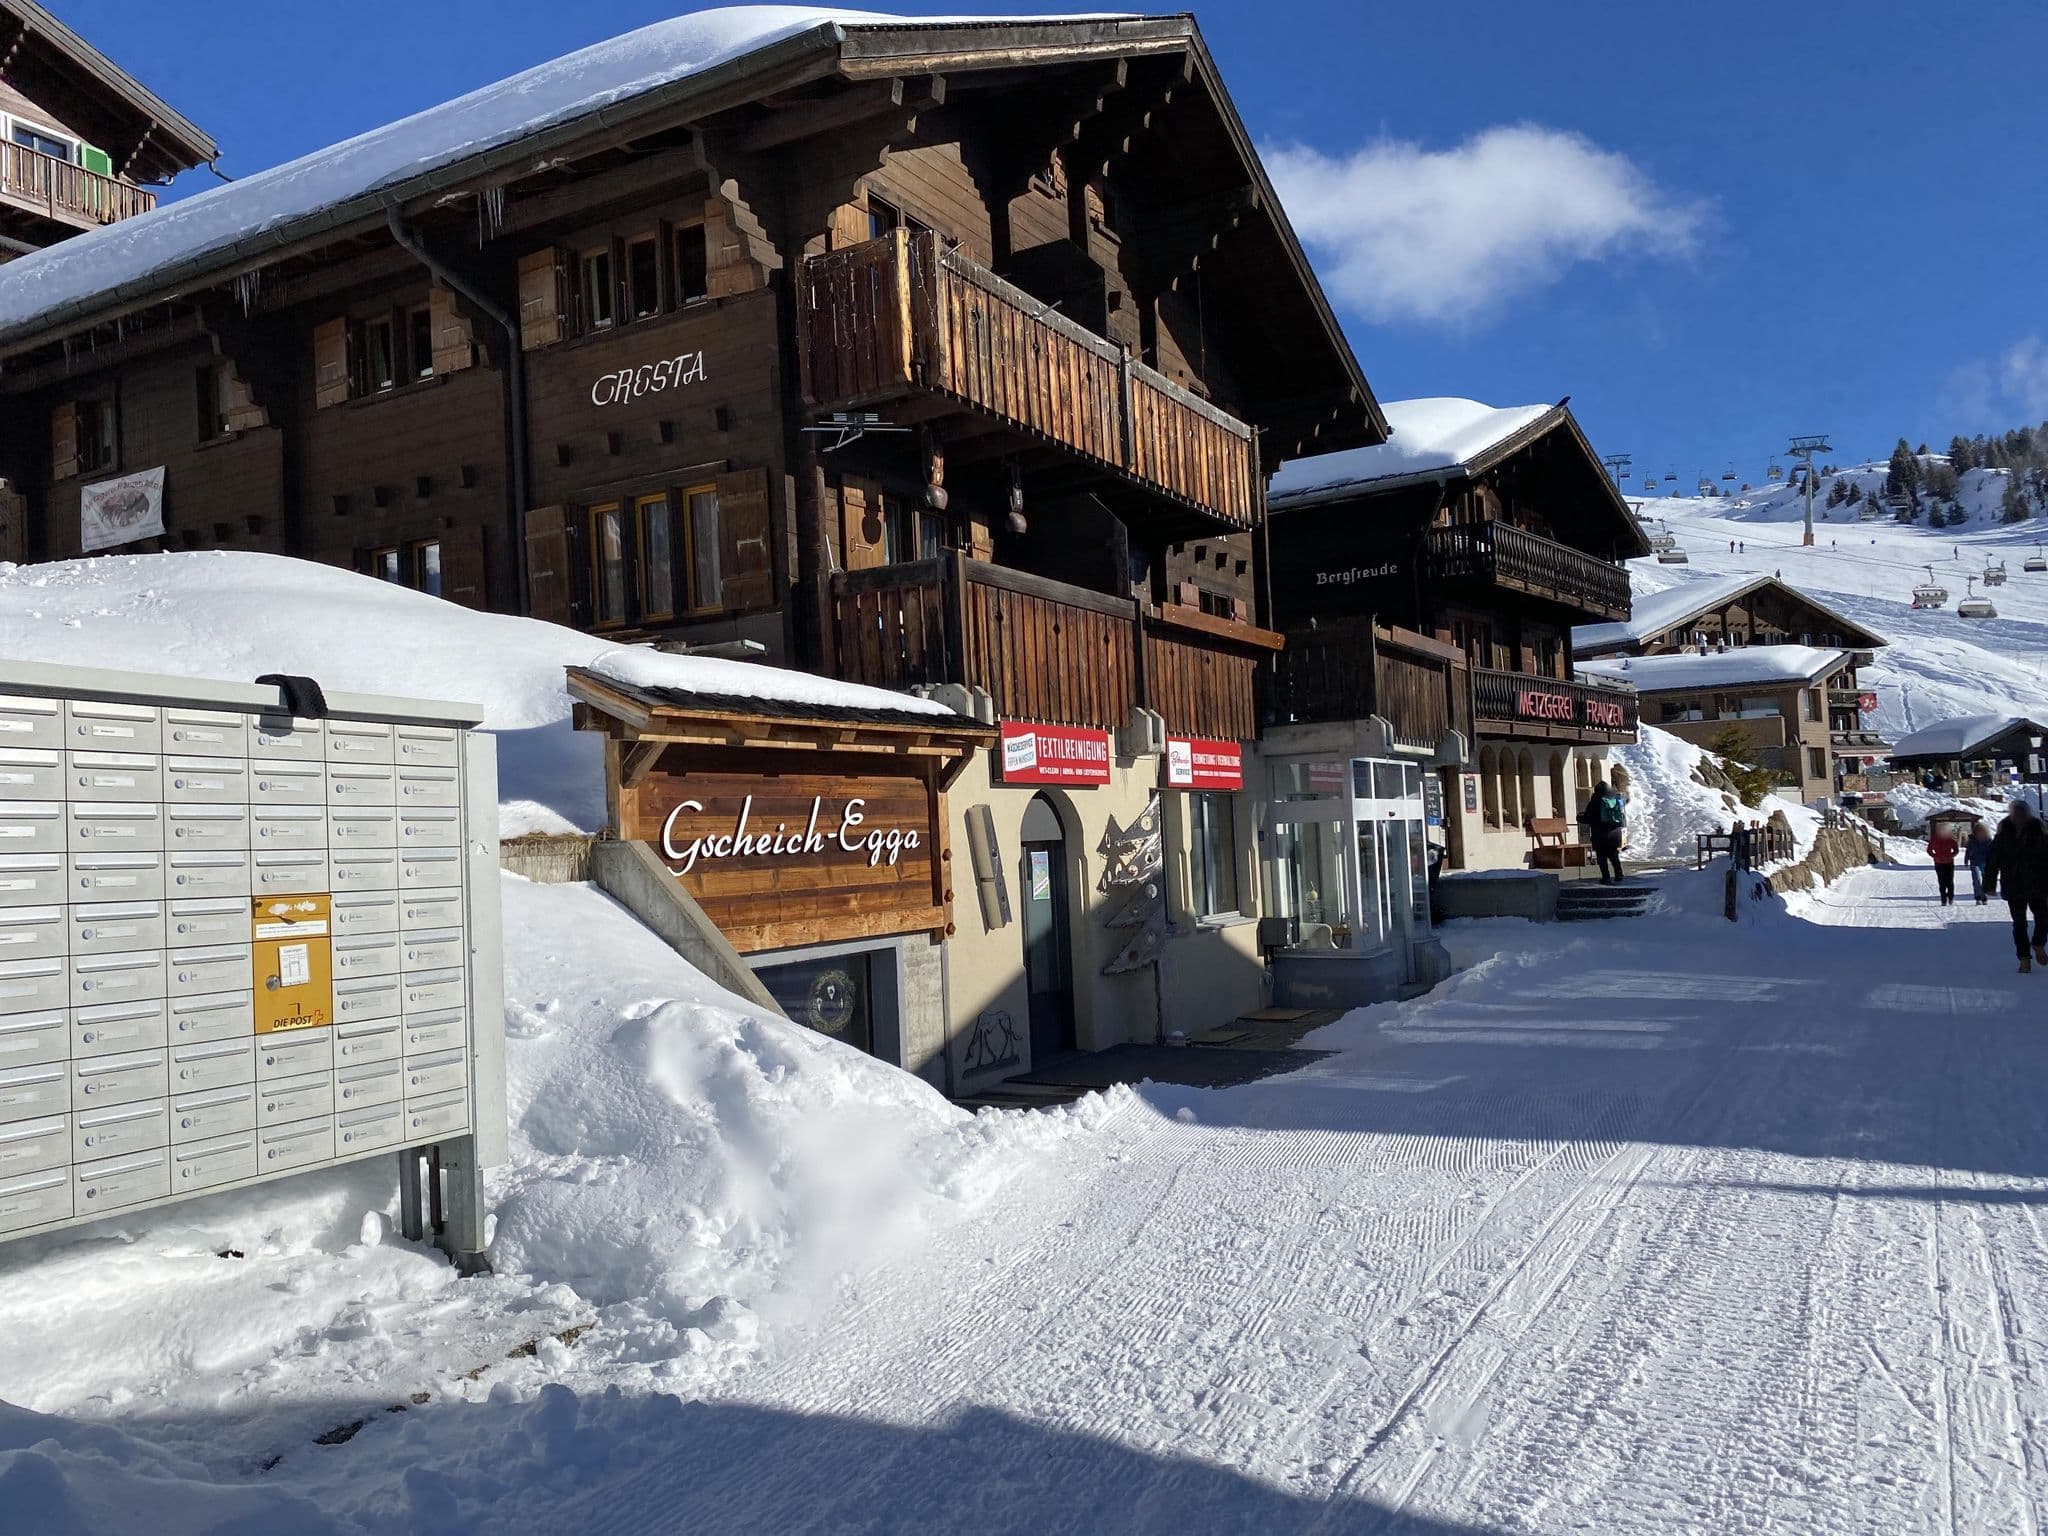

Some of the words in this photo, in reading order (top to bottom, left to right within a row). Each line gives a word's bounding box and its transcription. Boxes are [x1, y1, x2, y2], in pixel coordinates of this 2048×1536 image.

[591, 350, 708, 406] CRESTA
[1316, 562, 1398, 585] Bergfreude
[1520, 691, 1573, 720] METZGEREI
[1586, 700, 1624, 726] FRANZEN
[1037, 736, 1107, 761] TEXTILREINIGUNG
[662, 794, 921, 877] Gscheich-Egga
[273, 1018, 288, 1028] DIE
[290, 1014, 313, 1025] POST
